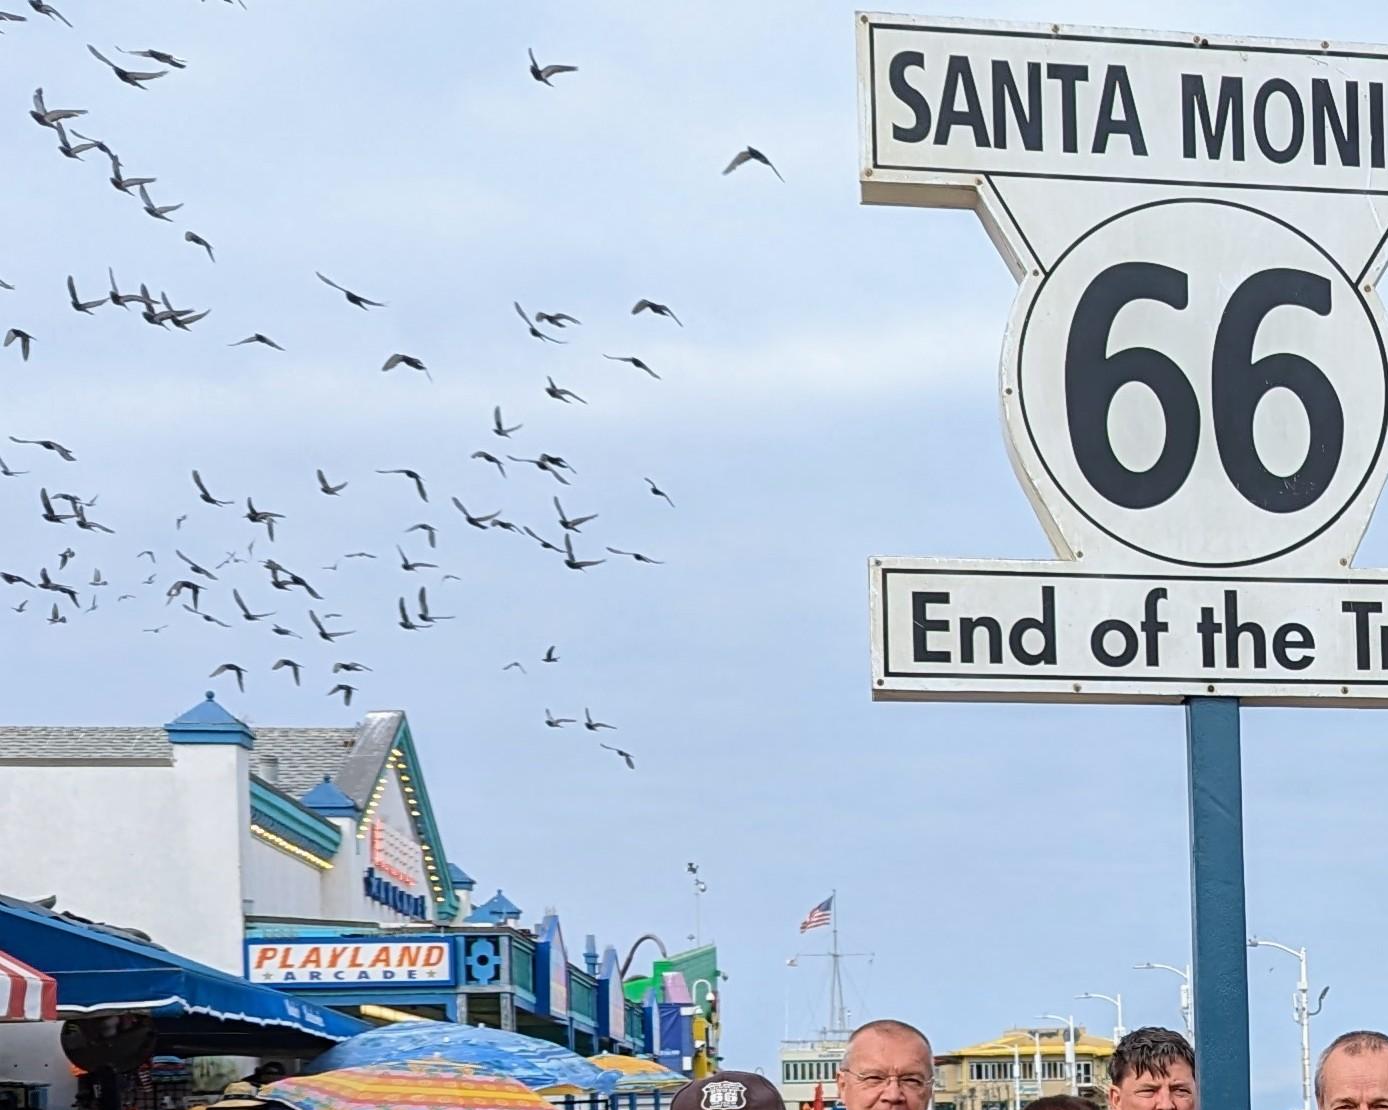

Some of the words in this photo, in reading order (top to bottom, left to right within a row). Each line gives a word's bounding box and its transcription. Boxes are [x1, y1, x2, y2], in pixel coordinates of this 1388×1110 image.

[889, 50, 1149, 156] SANTA
[1064, 261, 1345, 514] 66
[911, 585, 1056, 665] End
[1090, 587, 1169, 668] of
[1197, 589, 1315, 670] the
[254, 945, 445, 970] PLAYLAND
[284, 969, 417, 981] ARCADE
